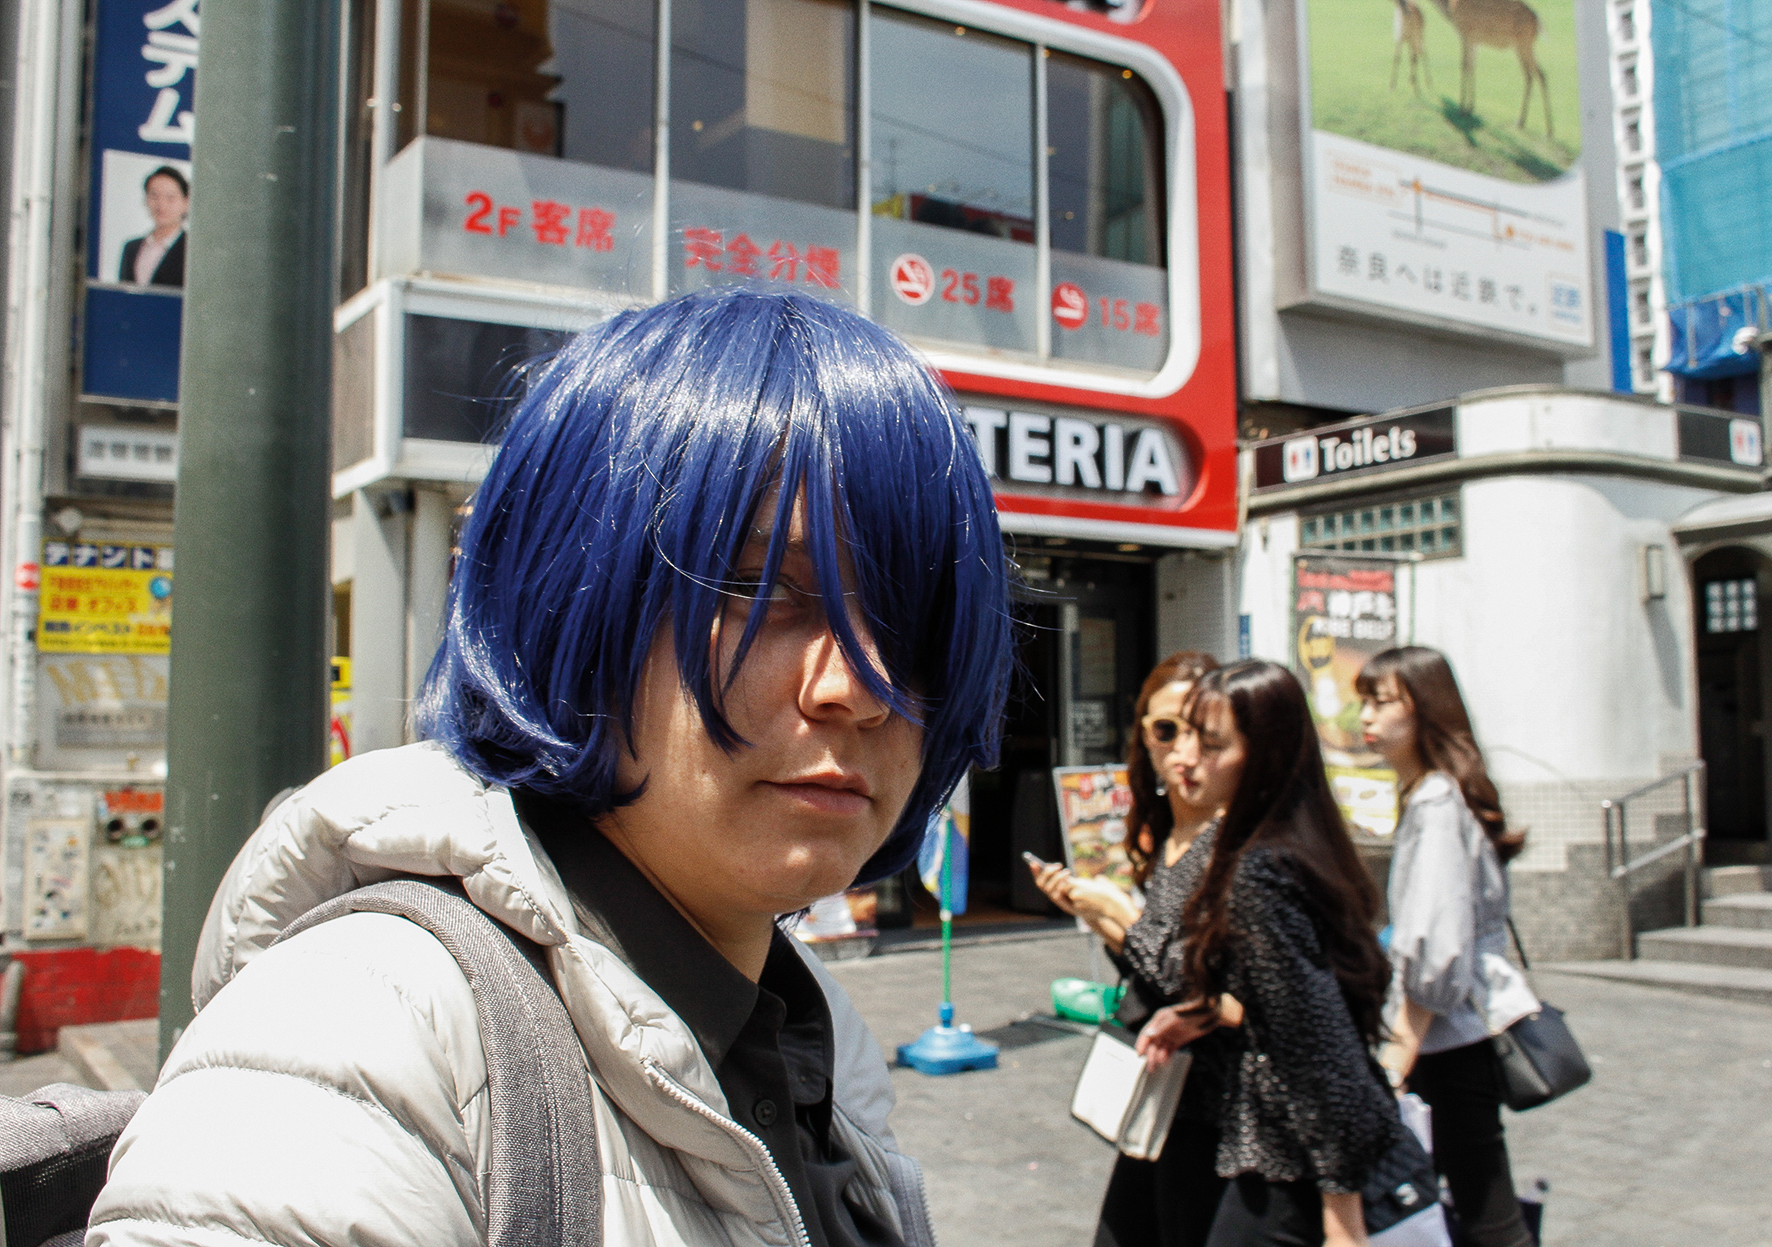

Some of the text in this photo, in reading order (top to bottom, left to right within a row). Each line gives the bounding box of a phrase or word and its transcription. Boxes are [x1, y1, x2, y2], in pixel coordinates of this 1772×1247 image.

[463, 190, 616, 252] 2F 客席
[941, 268, 1015, 313] 25席
[1099, 296, 1161, 337] 15席
[964, 407, 1179, 495] TERIA
[1319, 426, 1417, 472] Toilets
